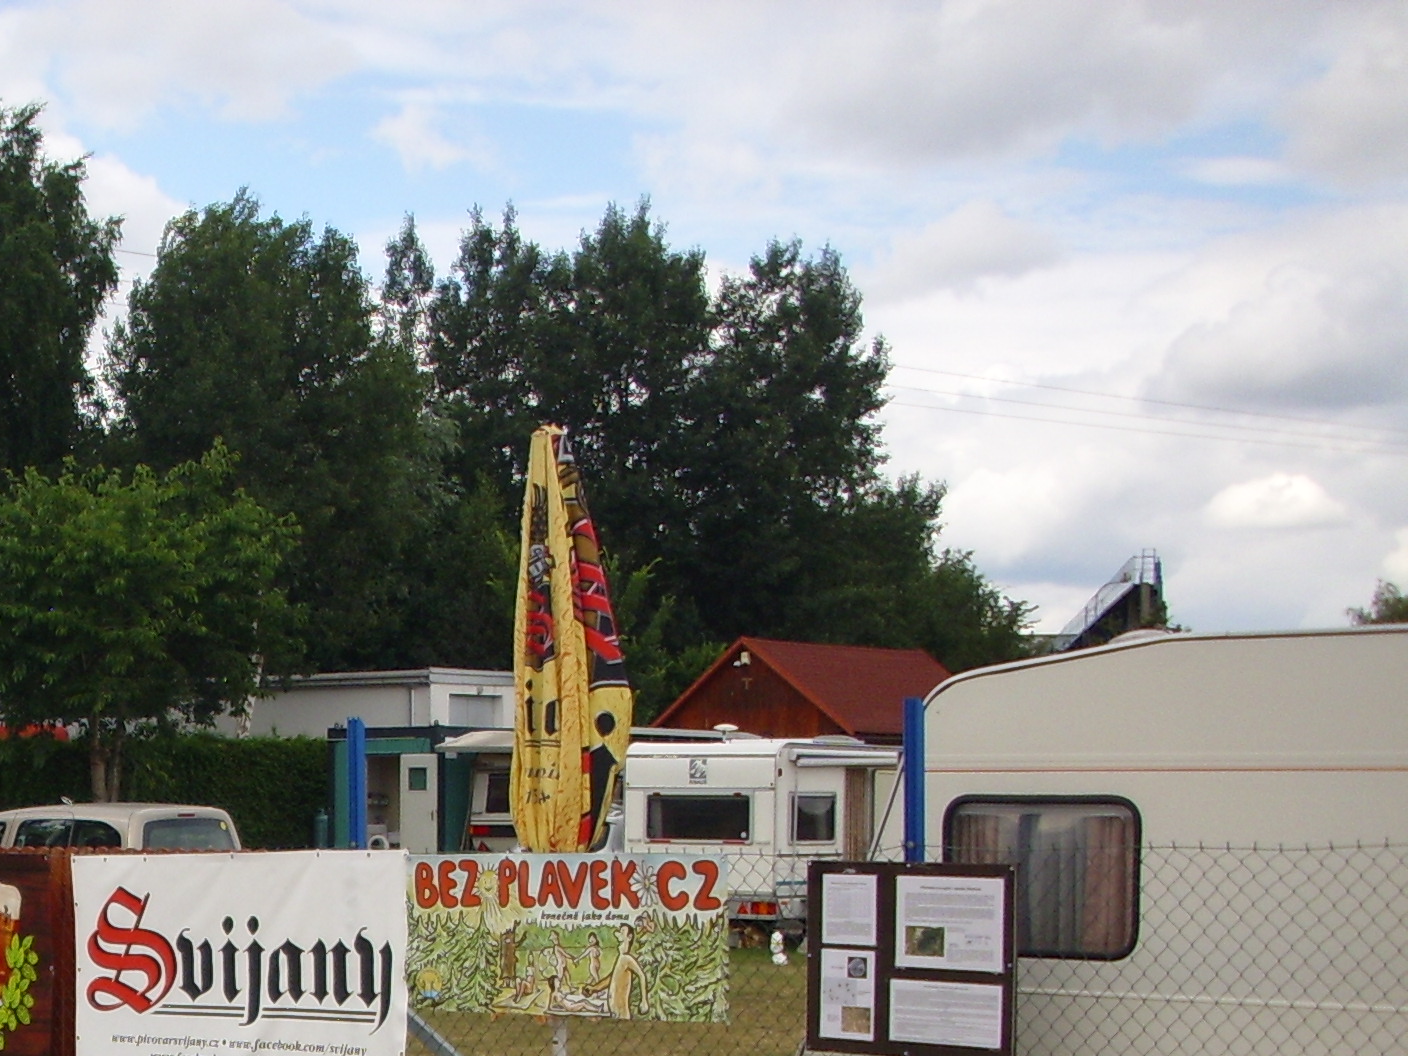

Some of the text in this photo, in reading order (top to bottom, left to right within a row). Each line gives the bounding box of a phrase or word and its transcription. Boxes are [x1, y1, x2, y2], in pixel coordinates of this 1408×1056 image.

[414, 859, 722, 911] BEZ PLAVEK CZ
[582, 911, 602, 922] jako
[605, 911, 630, 921] doma
[86, 886, 393, 1036] Svijany
